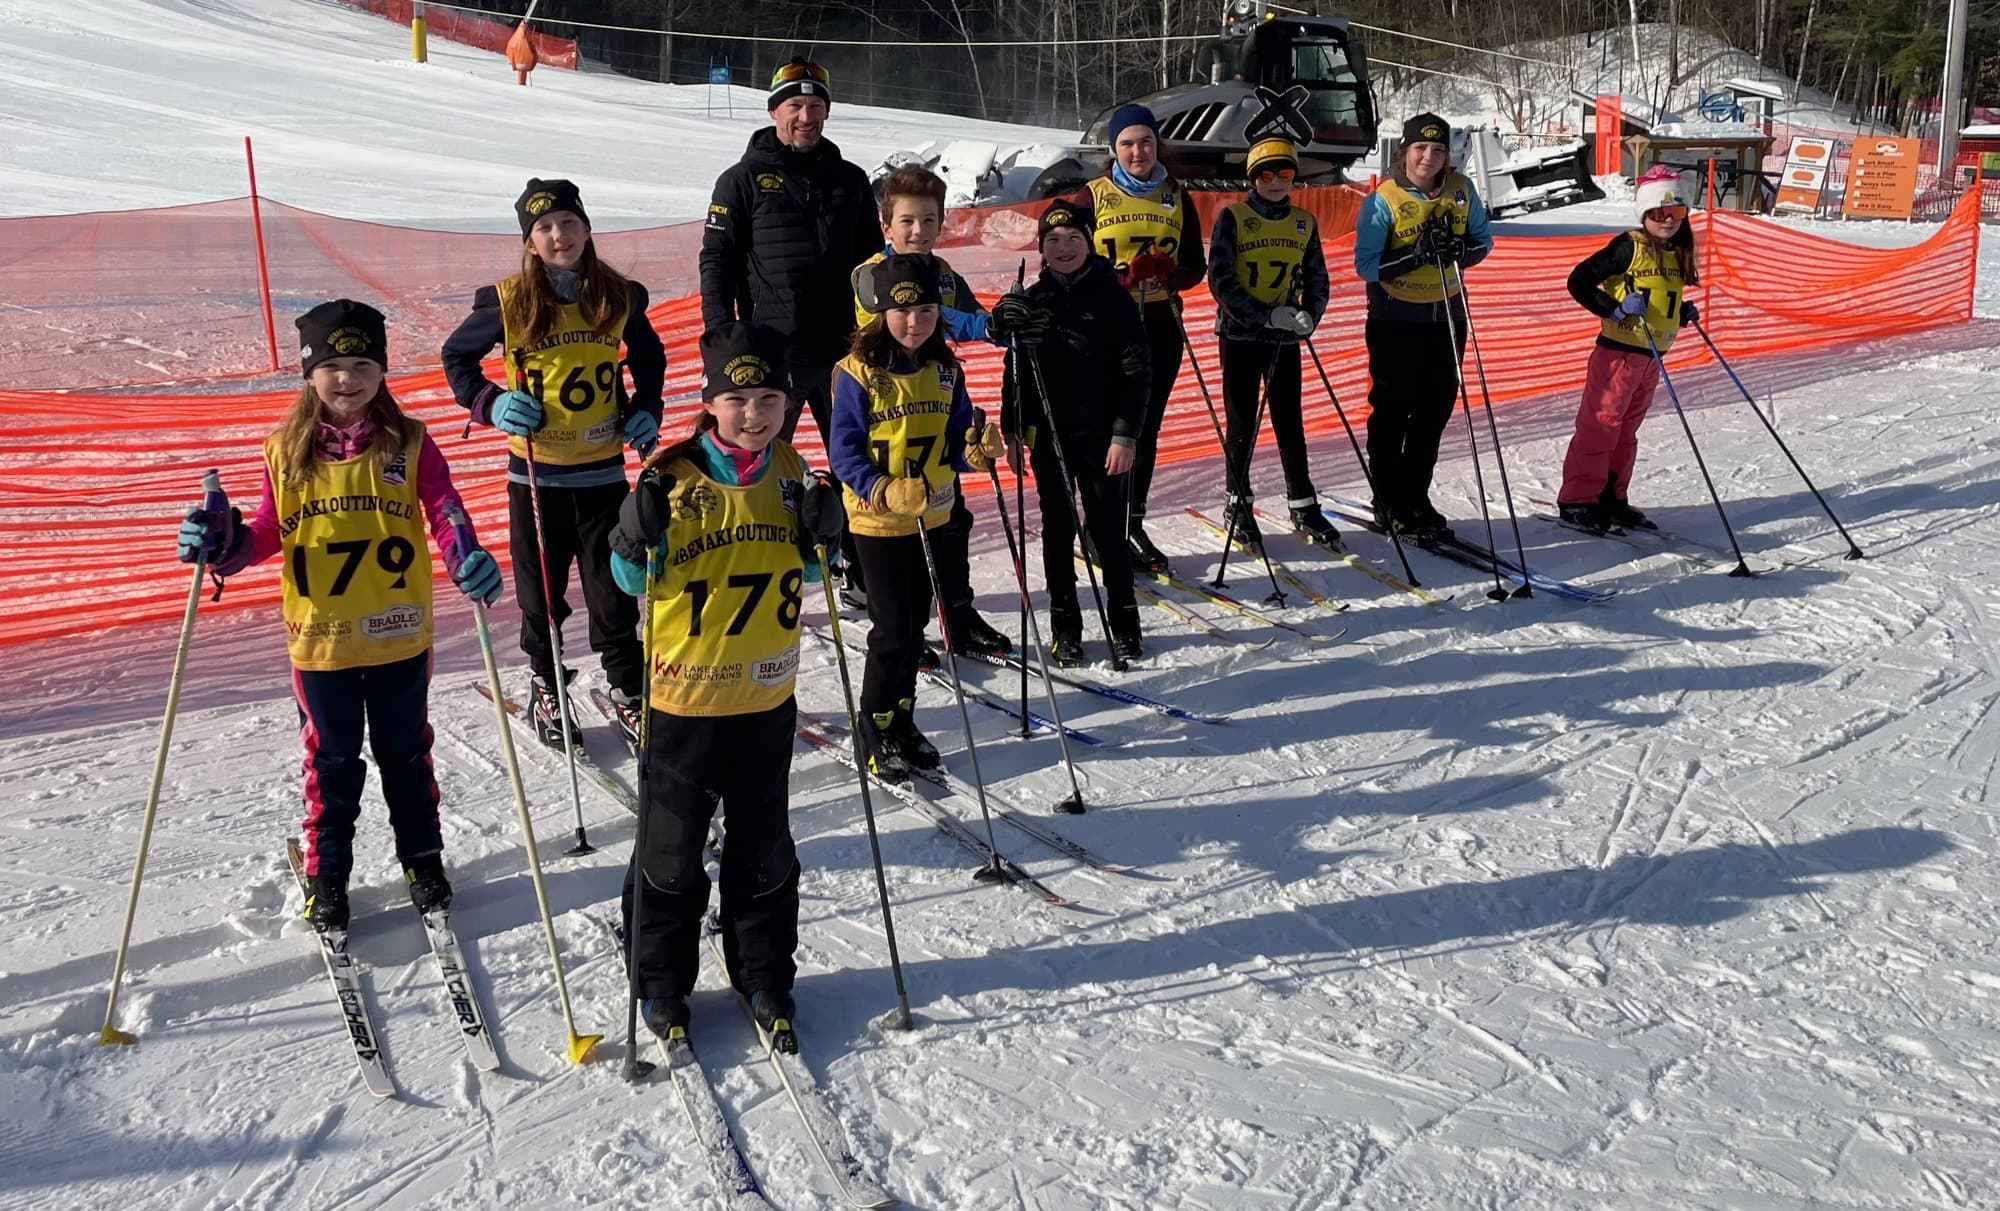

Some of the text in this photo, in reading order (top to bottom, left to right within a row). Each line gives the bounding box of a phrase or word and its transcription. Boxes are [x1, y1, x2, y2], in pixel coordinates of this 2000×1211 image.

[1132, 213, 1164, 223] OUTING
[528, 361, 616, 412] 169
[735, 523, 787, 543] OUTING
[292, 536, 415, 597] 179
[684, 568, 803, 636] 178
[369, 611, 419, 628] BRADLE
[966, 650, 1007, 667] SALOMON
[684, 663, 718, 673] LAKES
[721, 663, 743, 672] AND
[684, 671, 743, 682] MOUNTAINS
